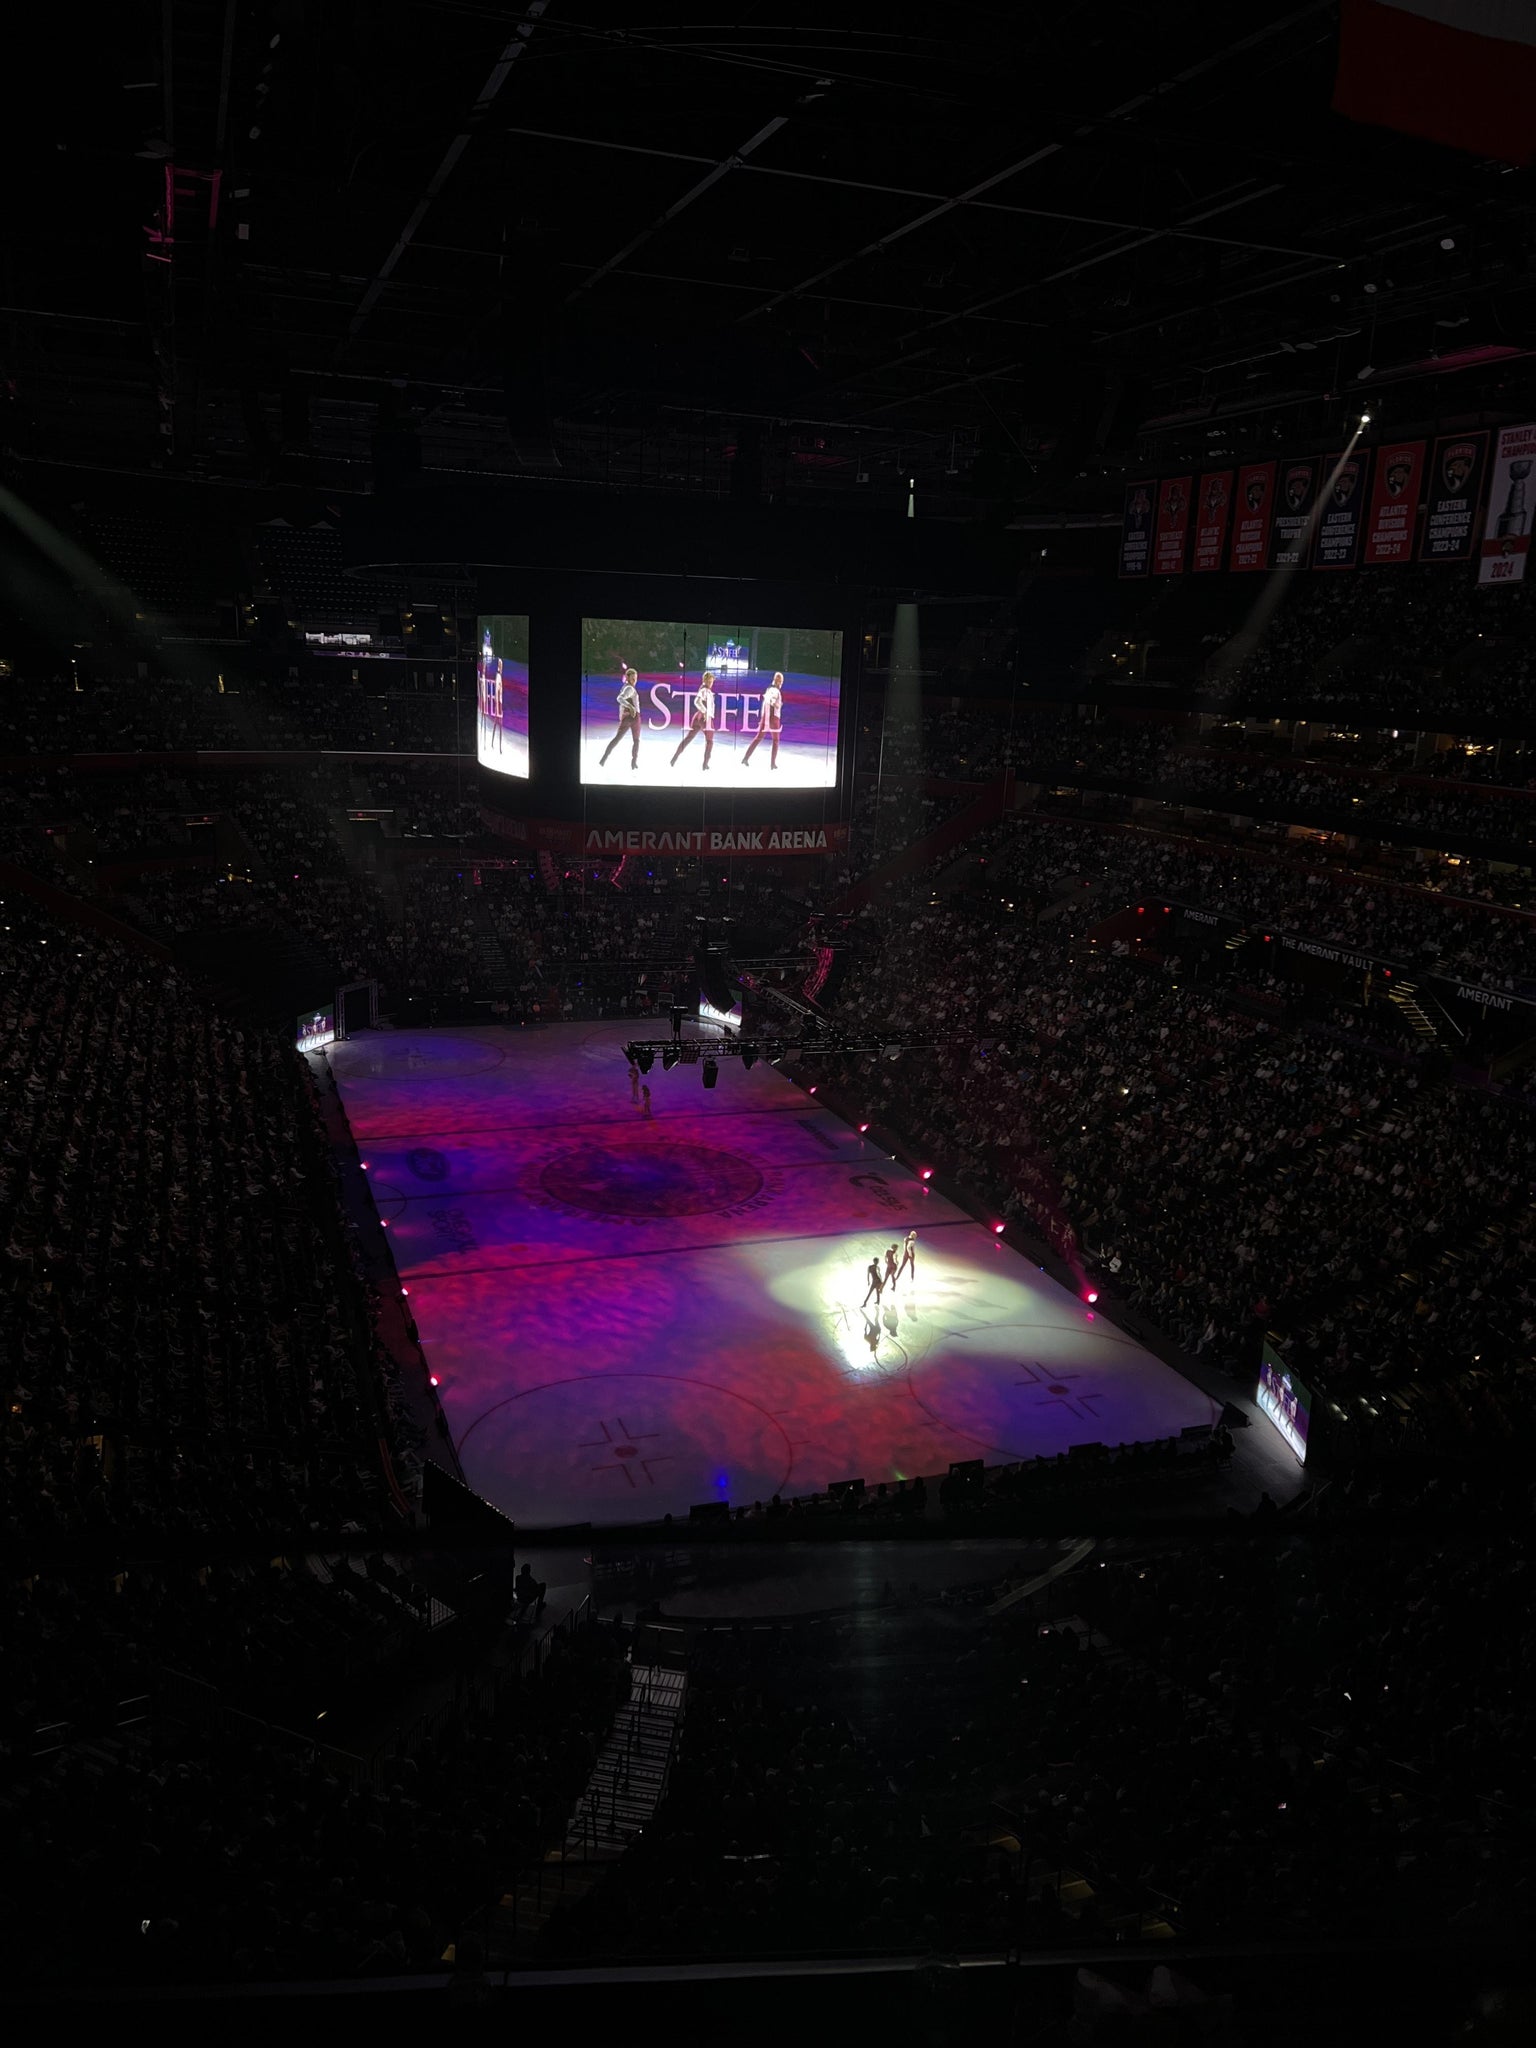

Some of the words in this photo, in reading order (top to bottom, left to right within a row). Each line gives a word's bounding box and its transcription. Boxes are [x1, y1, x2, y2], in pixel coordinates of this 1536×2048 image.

[1502, 430, 1532, 445] STANLEY
[1437, 499, 1467, 512] EASTERN
[1490, 562, 1514, 579] 2024
[648, 683, 783, 733] STIFEL
[586, 830, 707, 850] AMERANT
[710, 831, 763, 850] BANK
[768, 830, 828, 849] ARENA
[1183, 909, 1219, 927] AMERANT
[1281, 936, 1296, 949] THE
[1297, 941, 1341, 964] AMERANT
[1341, 953, 1375, 972] VAULT
[1456, 986, 1514, 1011] AMERANT
